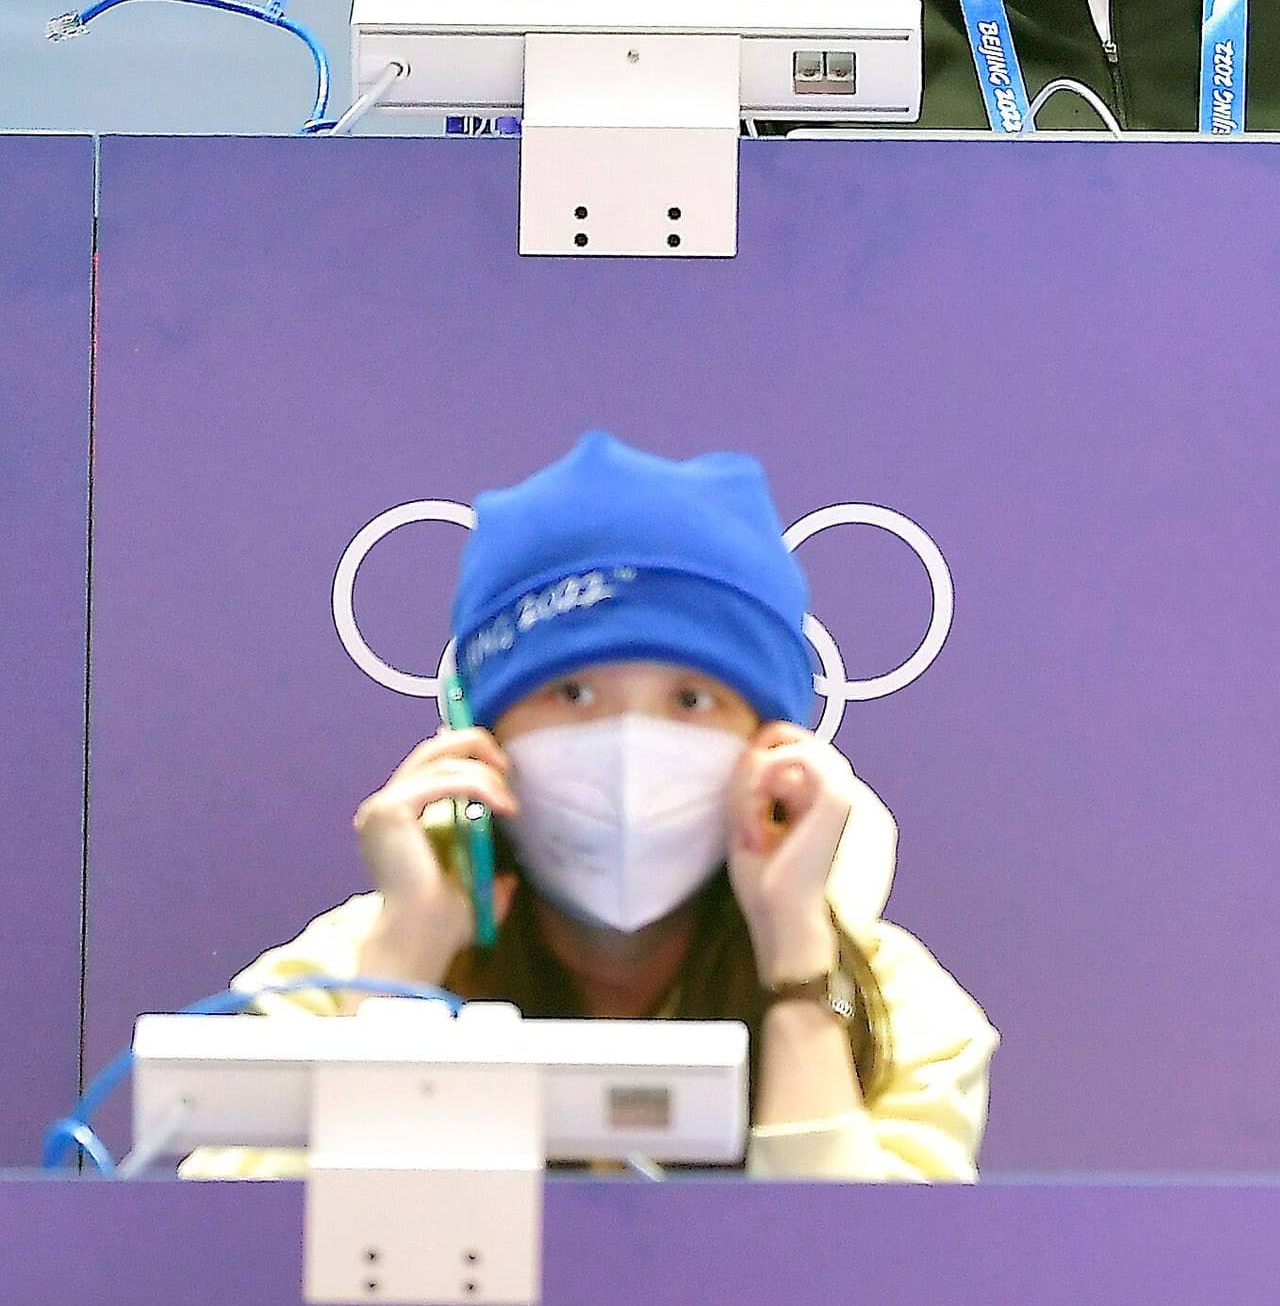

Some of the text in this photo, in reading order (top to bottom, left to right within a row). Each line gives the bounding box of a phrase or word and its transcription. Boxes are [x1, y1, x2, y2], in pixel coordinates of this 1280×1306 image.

[978, 21, 1011, 86] BEIJING
[1211, 39, 1238, 134] IJING 2022
